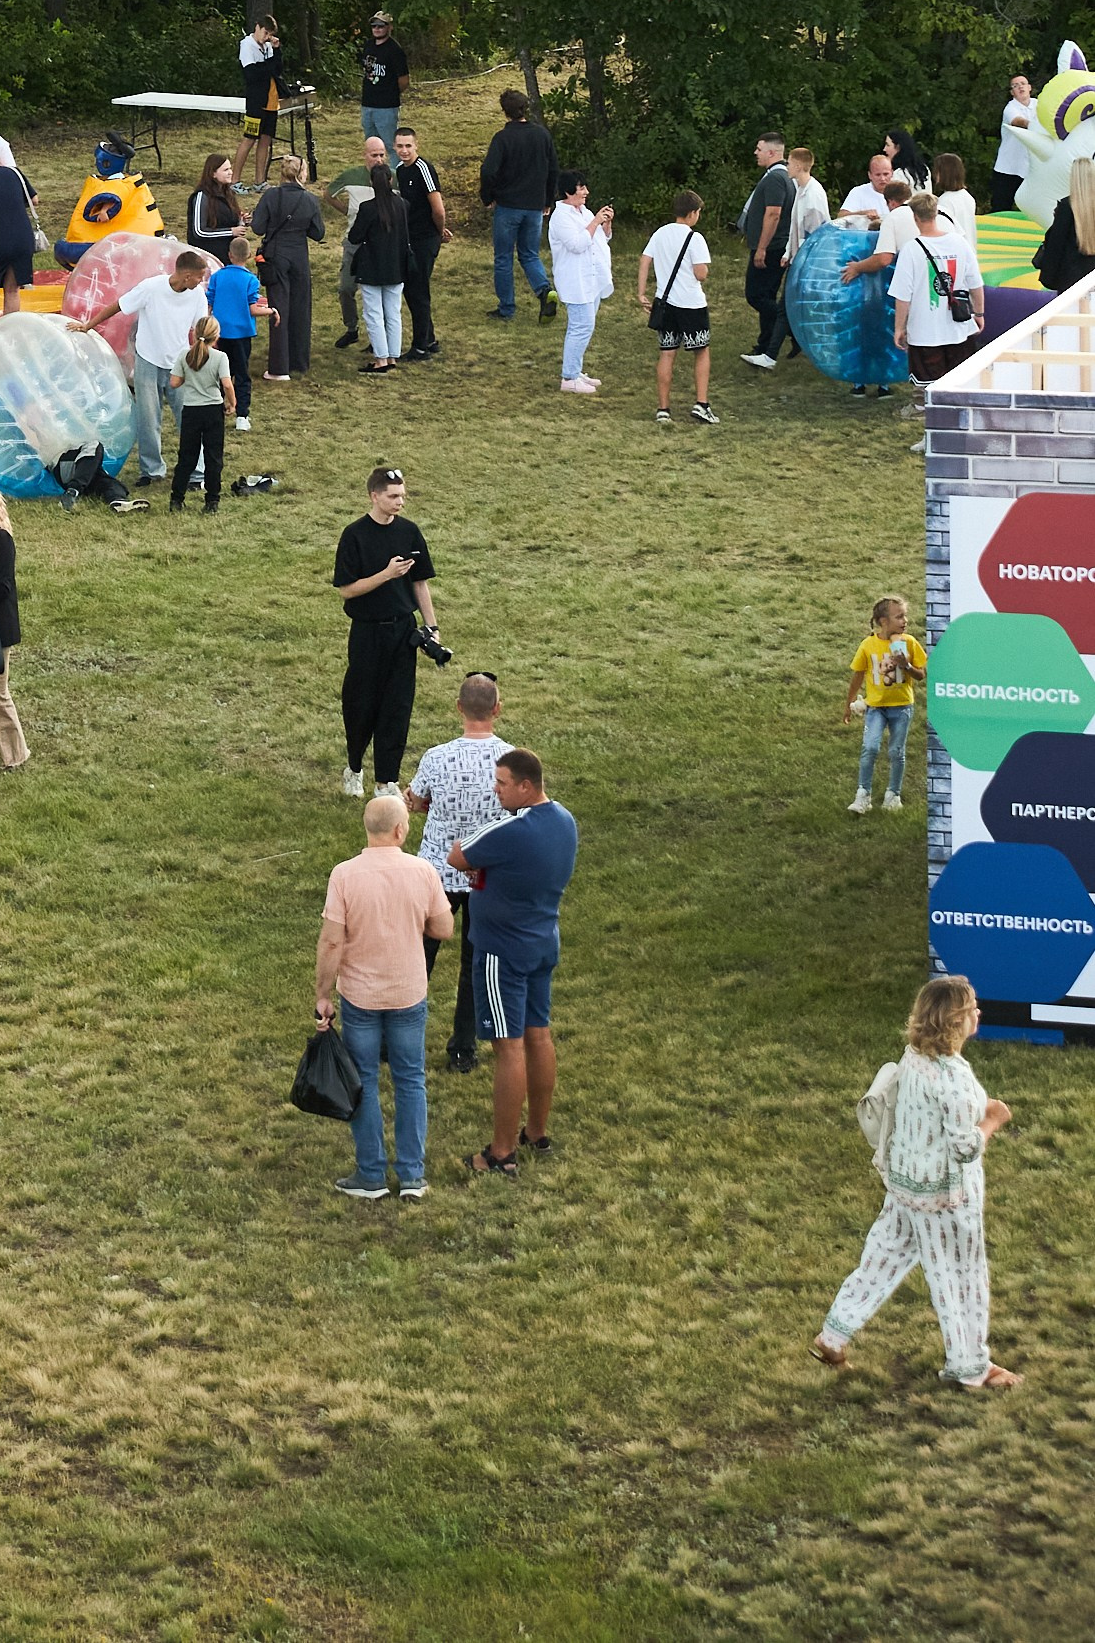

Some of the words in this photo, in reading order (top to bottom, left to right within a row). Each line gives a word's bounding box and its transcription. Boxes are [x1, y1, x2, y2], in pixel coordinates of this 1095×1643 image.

[934, 682, 1080, 704] БЕЗОПАСНОСТЬ
[1011, 803, 1095, 821] ПАРТНЕРС
[931, 910, 1094, 935] ОТВЕТСТВЕННОСТЬ
